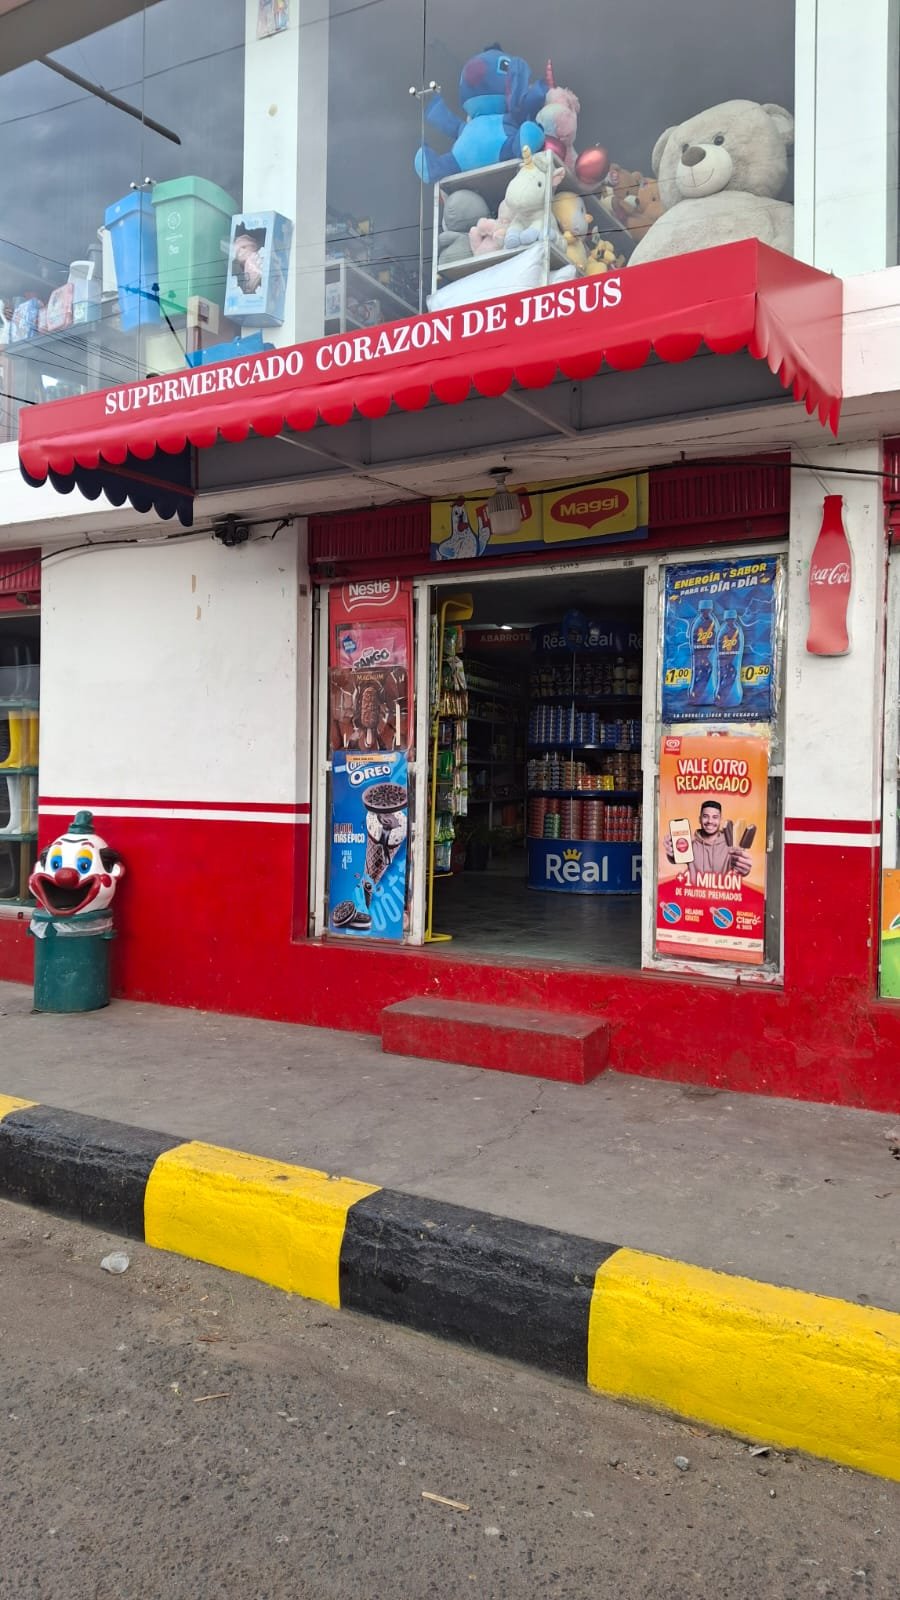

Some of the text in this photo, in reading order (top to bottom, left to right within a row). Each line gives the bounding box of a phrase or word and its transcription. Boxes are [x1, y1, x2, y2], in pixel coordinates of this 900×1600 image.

[104, 277, 623, 415] SUPERMERCADO CORAZON DE JESUS
[560, 495, 619, 517] Maggi
[674, 572, 720, 590] ENERGÍA
[729, 562, 767, 578] SABOR
[680, 588, 698, 596] PARA
[710, 581, 730, 594] DÍA
[737, 575, 758, 588] DÍA
[480, 633, 530, 642] ABARROTE
[543, 635, 566, 649] Rea
[350, 765, 391, 785] OREO
[679, 758, 747, 777] VALE OTRO
[676, 775, 749, 794] RECARGADO
[546, 854, 608, 884] Real
[677, 871, 742, 891] +1 MILLÓN
[675, 887, 682, 896] DE
[708, 890, 742, 902] PREMIADOS
[736, 916, 759, 926] Claro
